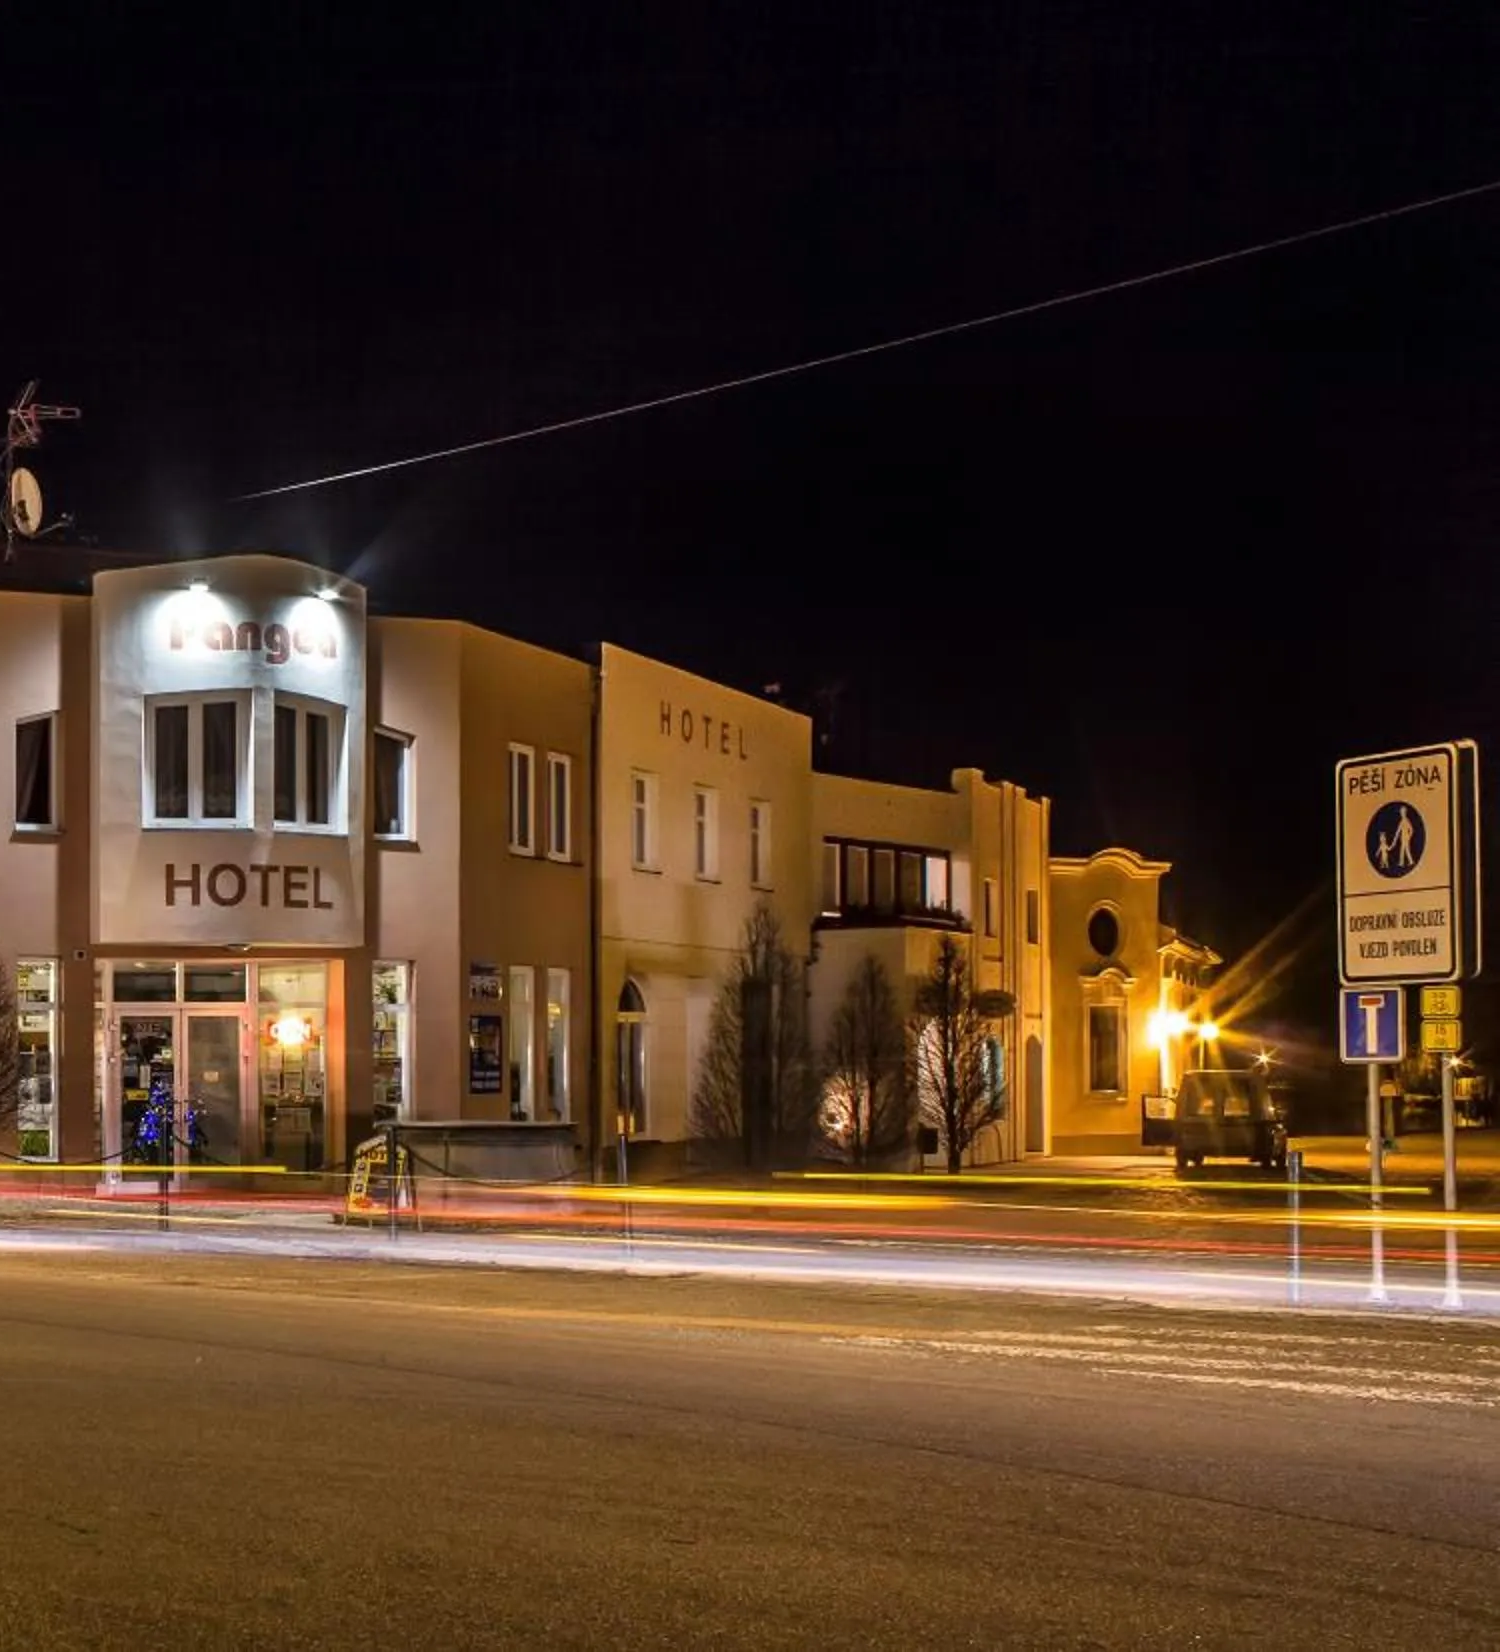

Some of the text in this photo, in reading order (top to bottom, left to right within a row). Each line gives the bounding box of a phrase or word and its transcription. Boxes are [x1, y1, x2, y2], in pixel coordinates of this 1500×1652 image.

[659, 700, 748, 761] HOTEL
[1394, 763, 1442, 790] ZÓNA
[164, 863, 334, 909] HOTEL
